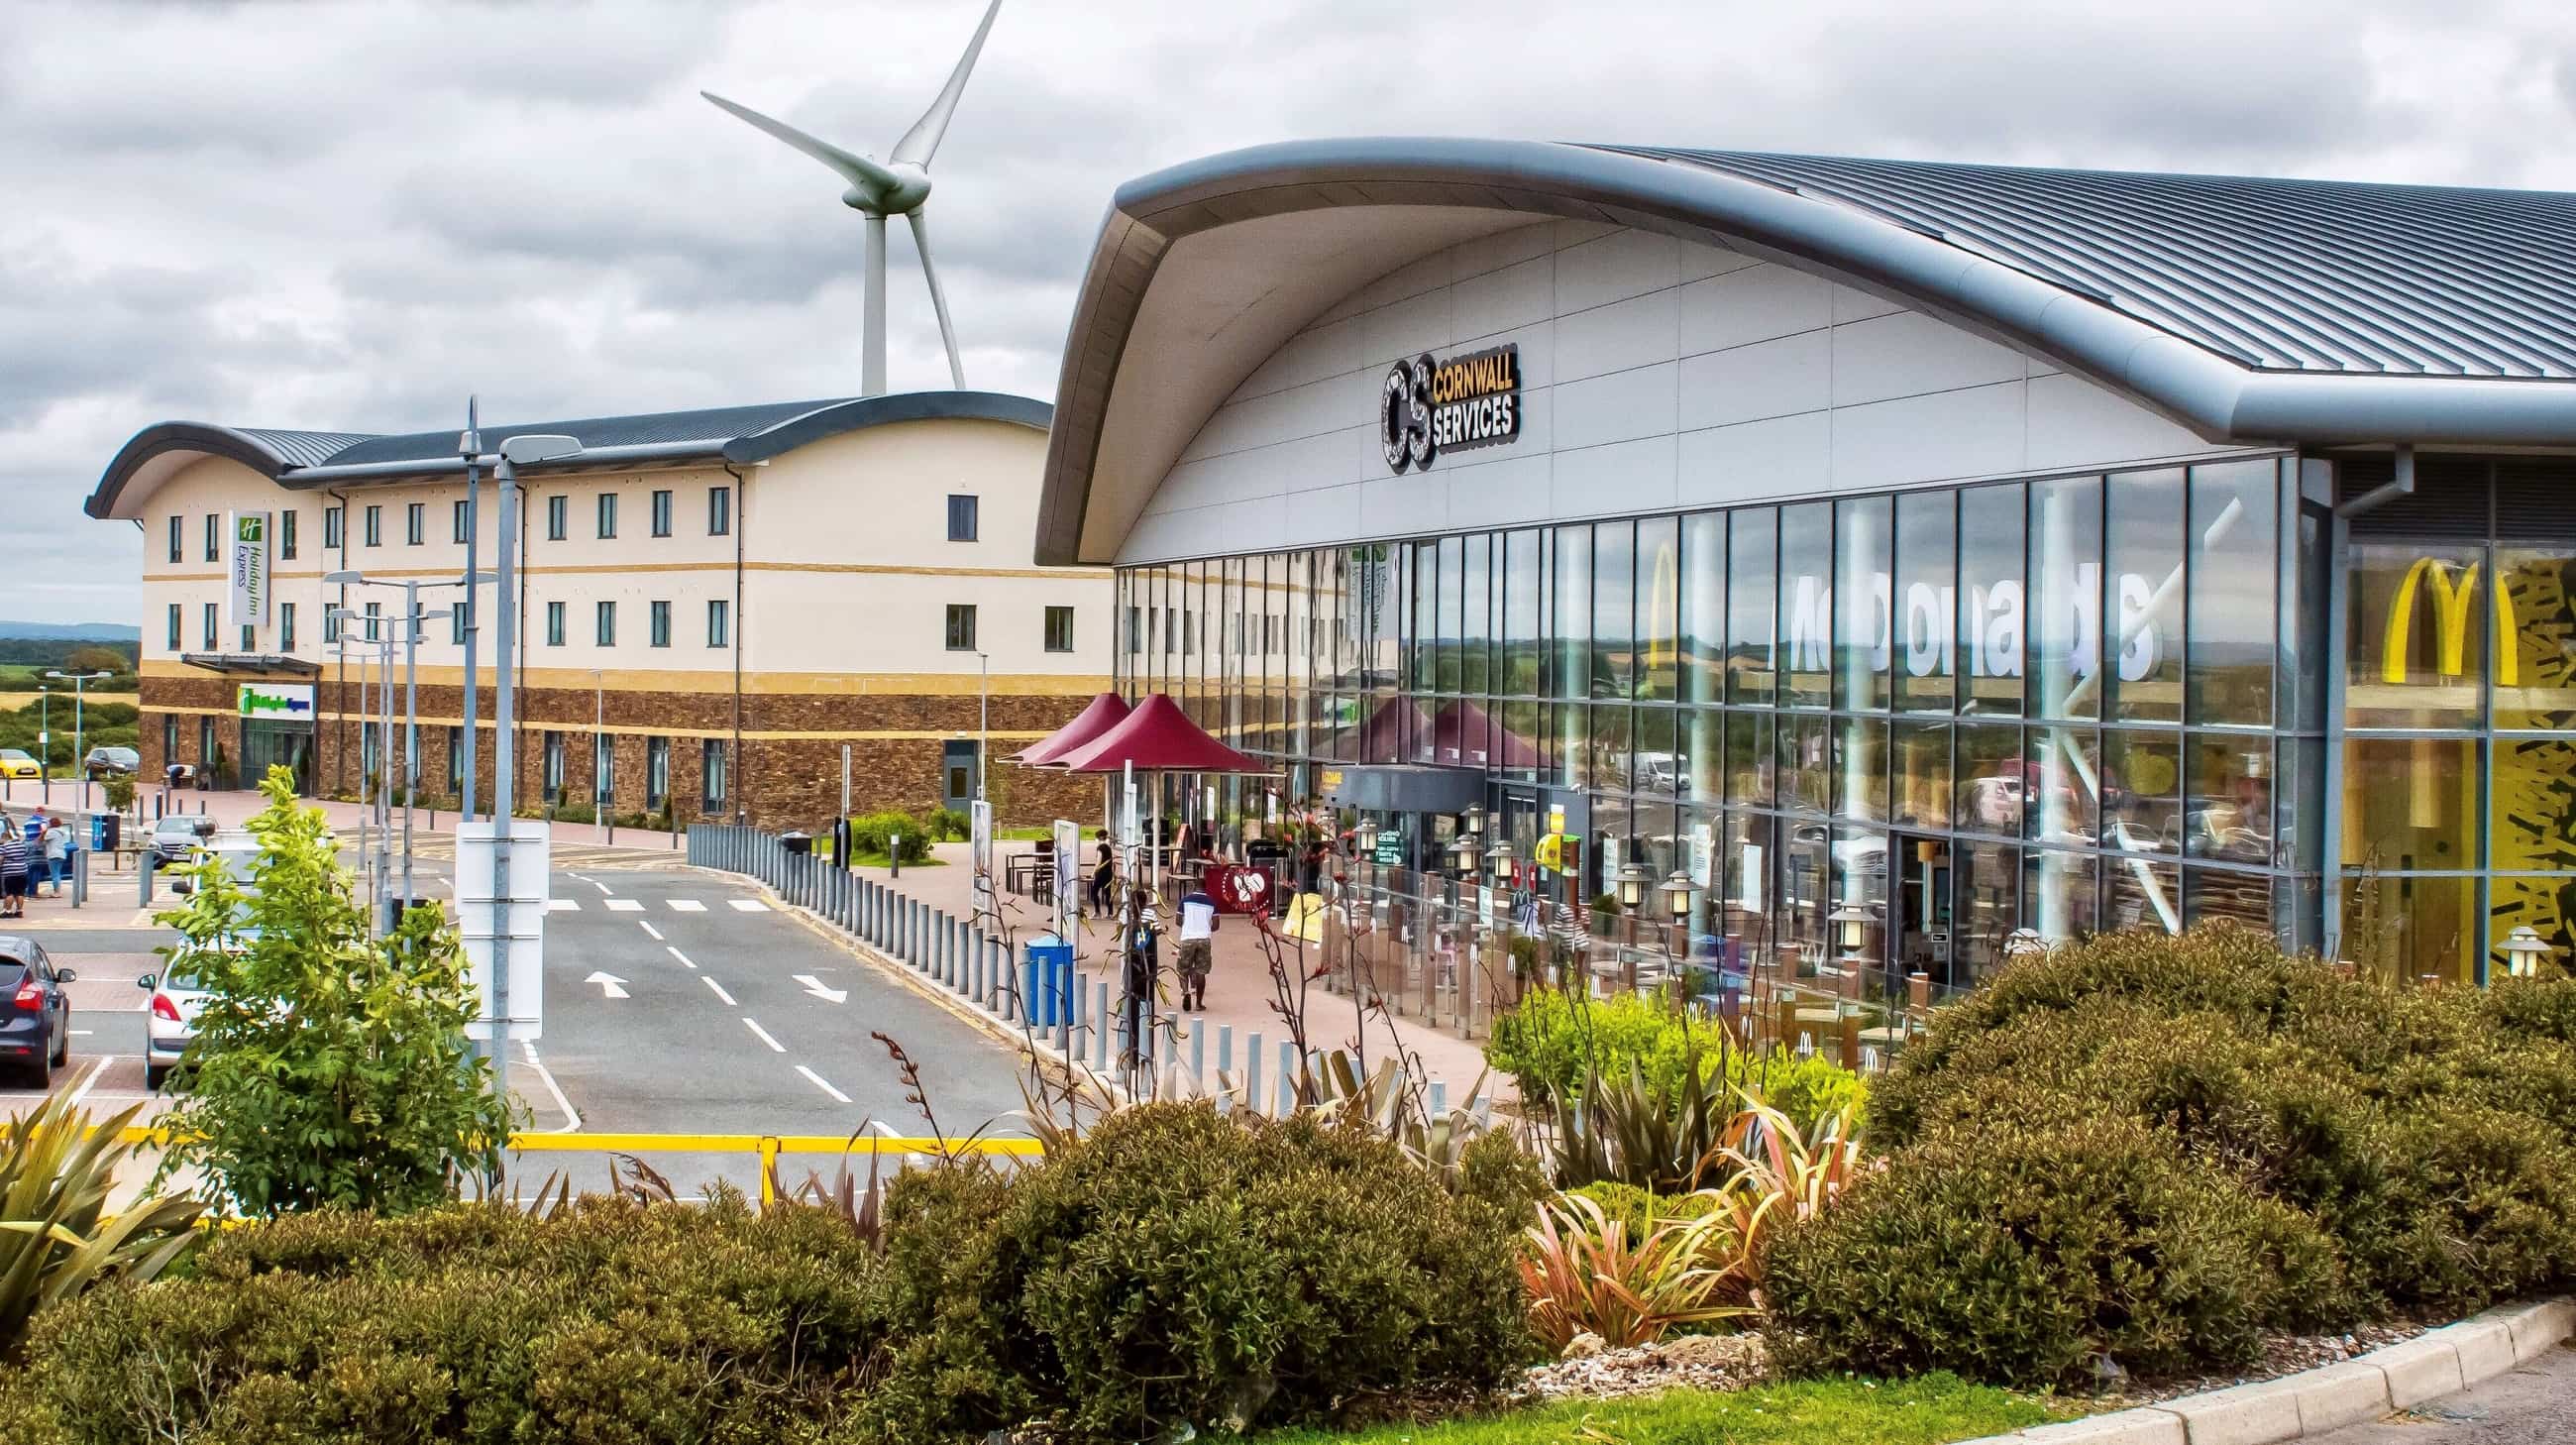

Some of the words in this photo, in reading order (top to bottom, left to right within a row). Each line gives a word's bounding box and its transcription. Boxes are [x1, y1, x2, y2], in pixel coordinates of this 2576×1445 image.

[1434, 352, 1513, 402] CORNWALL
[1433, 394, 1513, 447] SERVICES
[237, 545, 249, 588] Express
[247, 546, 262, 595] Holiday
[249, 596, 262, 615] Inn
[1768, 563, 2155, 681] MDonads
